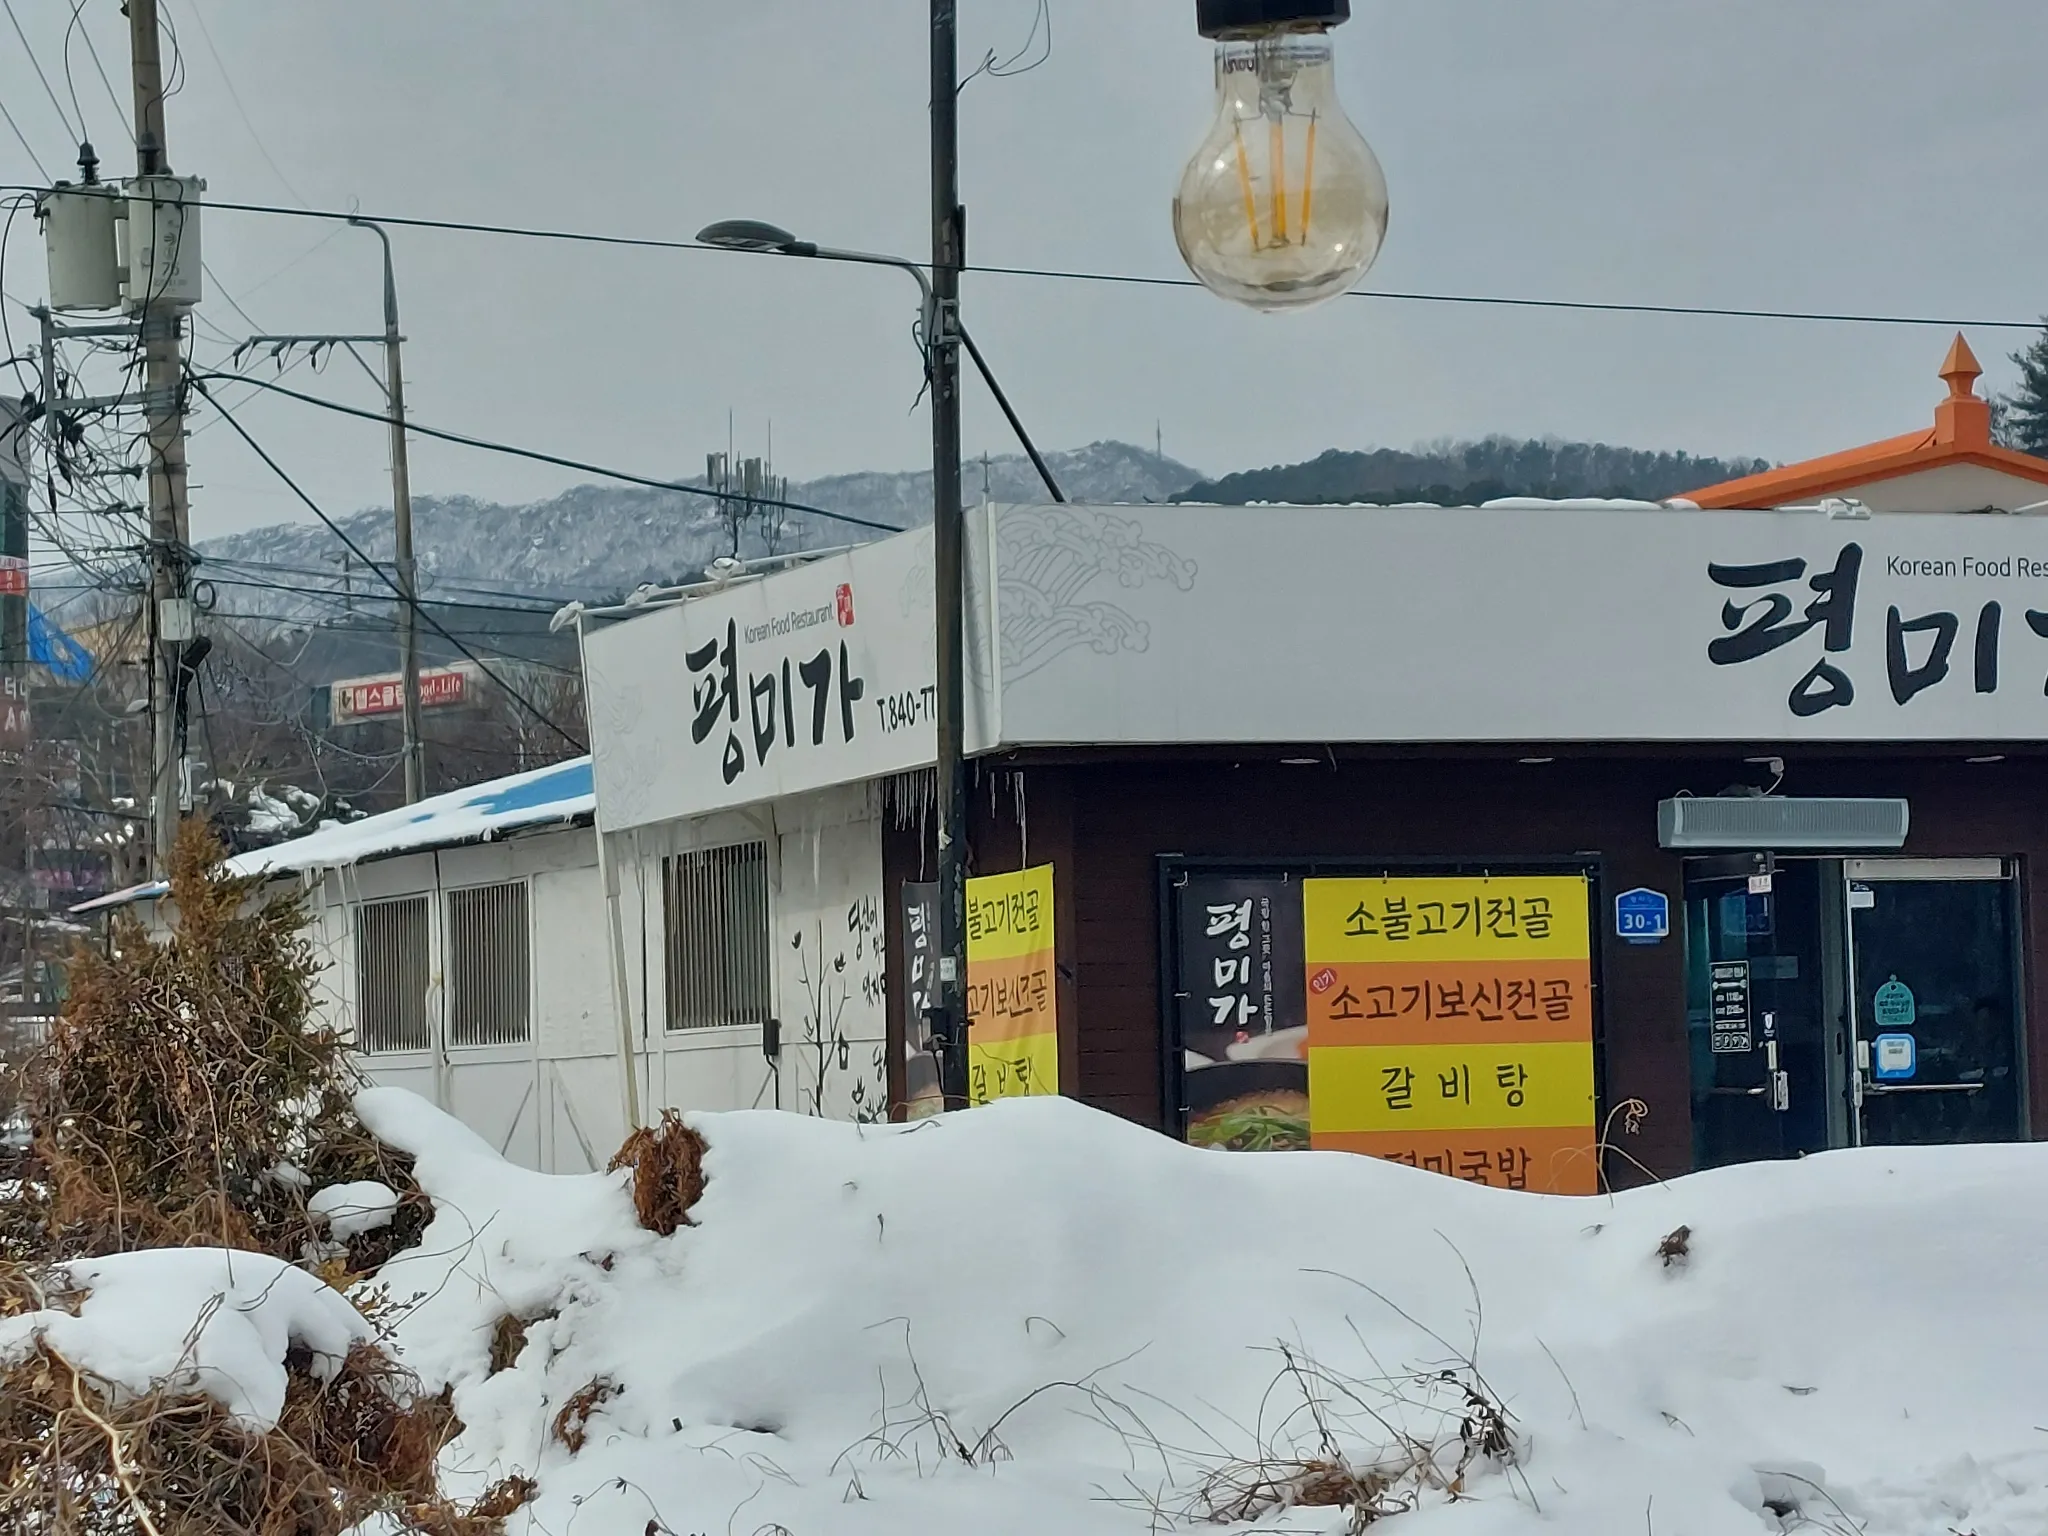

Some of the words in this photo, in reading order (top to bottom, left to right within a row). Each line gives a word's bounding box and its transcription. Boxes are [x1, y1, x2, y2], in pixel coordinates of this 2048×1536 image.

[1887, 555, 1957, 577] Korean
[1963, 556, 2011, 577] Food
[743, 620, 771, 644] Korean
[770, 611, 791, 638] Food
[791, 601, 835, 631] Restaurant
[1707, 541, 2048, 717] 평미
[684, 616, 865, 786] 평미가
[1344, 895, 1554, 941] 소불고기전골
[1623, 913, 1662, 931] 30-1
[1204, 897, 1260, 1026] 평미가
[1312, 969, 1336, 992] 인기
[1329, 978, 1574, 1023] 소고기보신전골
